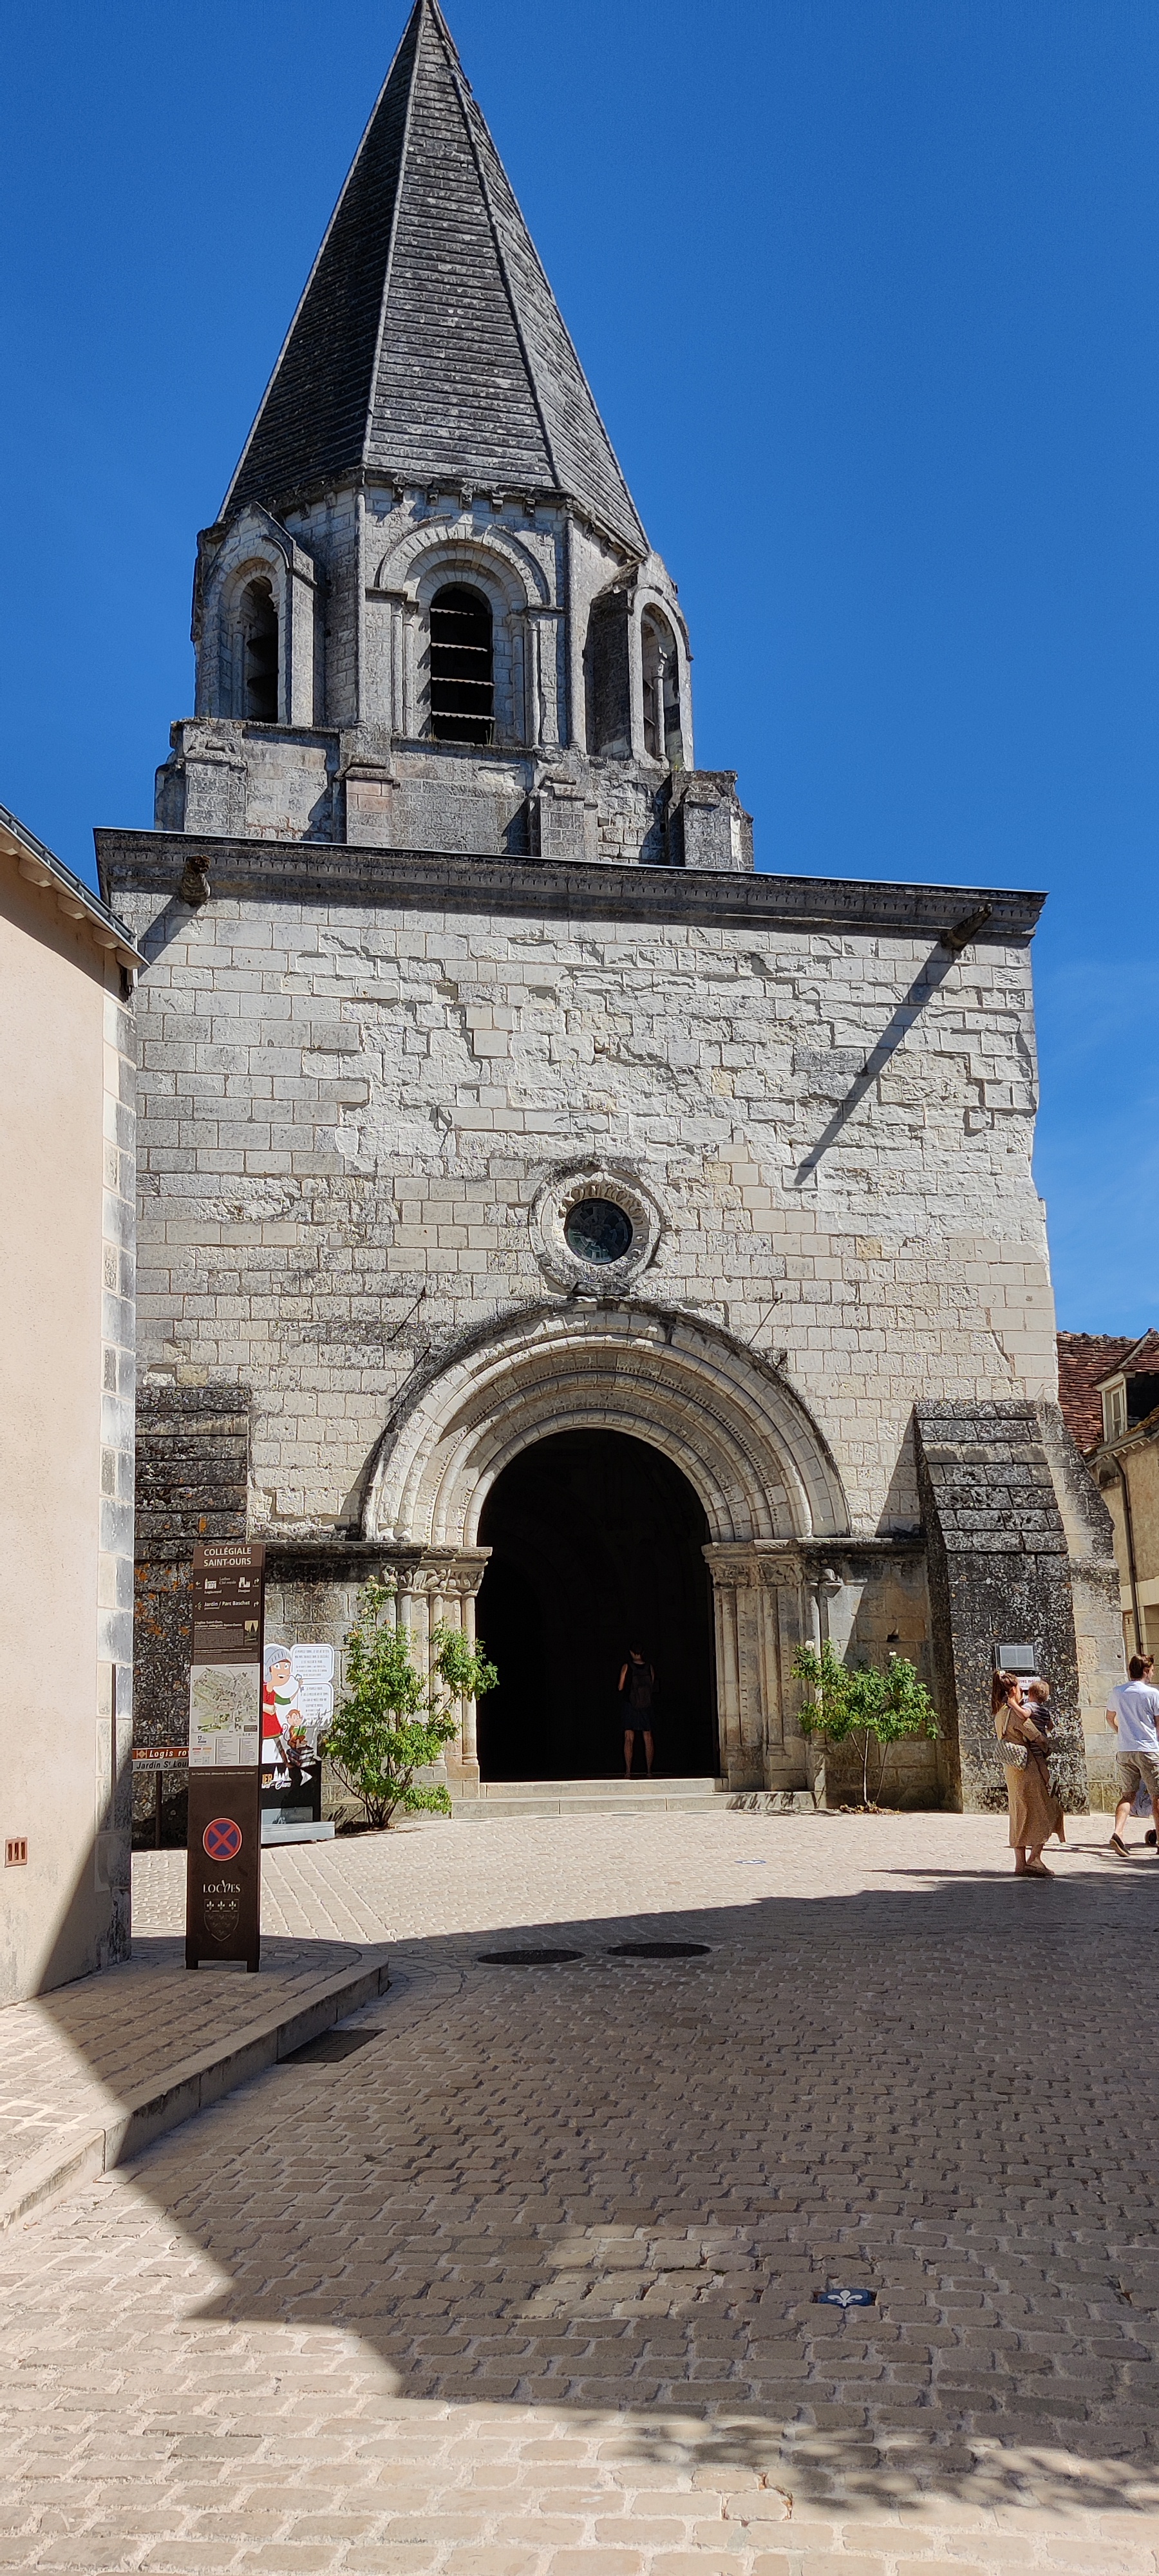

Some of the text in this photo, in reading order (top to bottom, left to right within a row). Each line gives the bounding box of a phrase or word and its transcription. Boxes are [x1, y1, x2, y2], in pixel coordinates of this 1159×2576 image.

[203, 1546, 252, 1556] COLLÉGIALE
[203, 1557, 252, 1567] SAINT-OURS
[149, 1749, 174, 1759] Logis
[136, 1761, 160, 1770] Jardin
